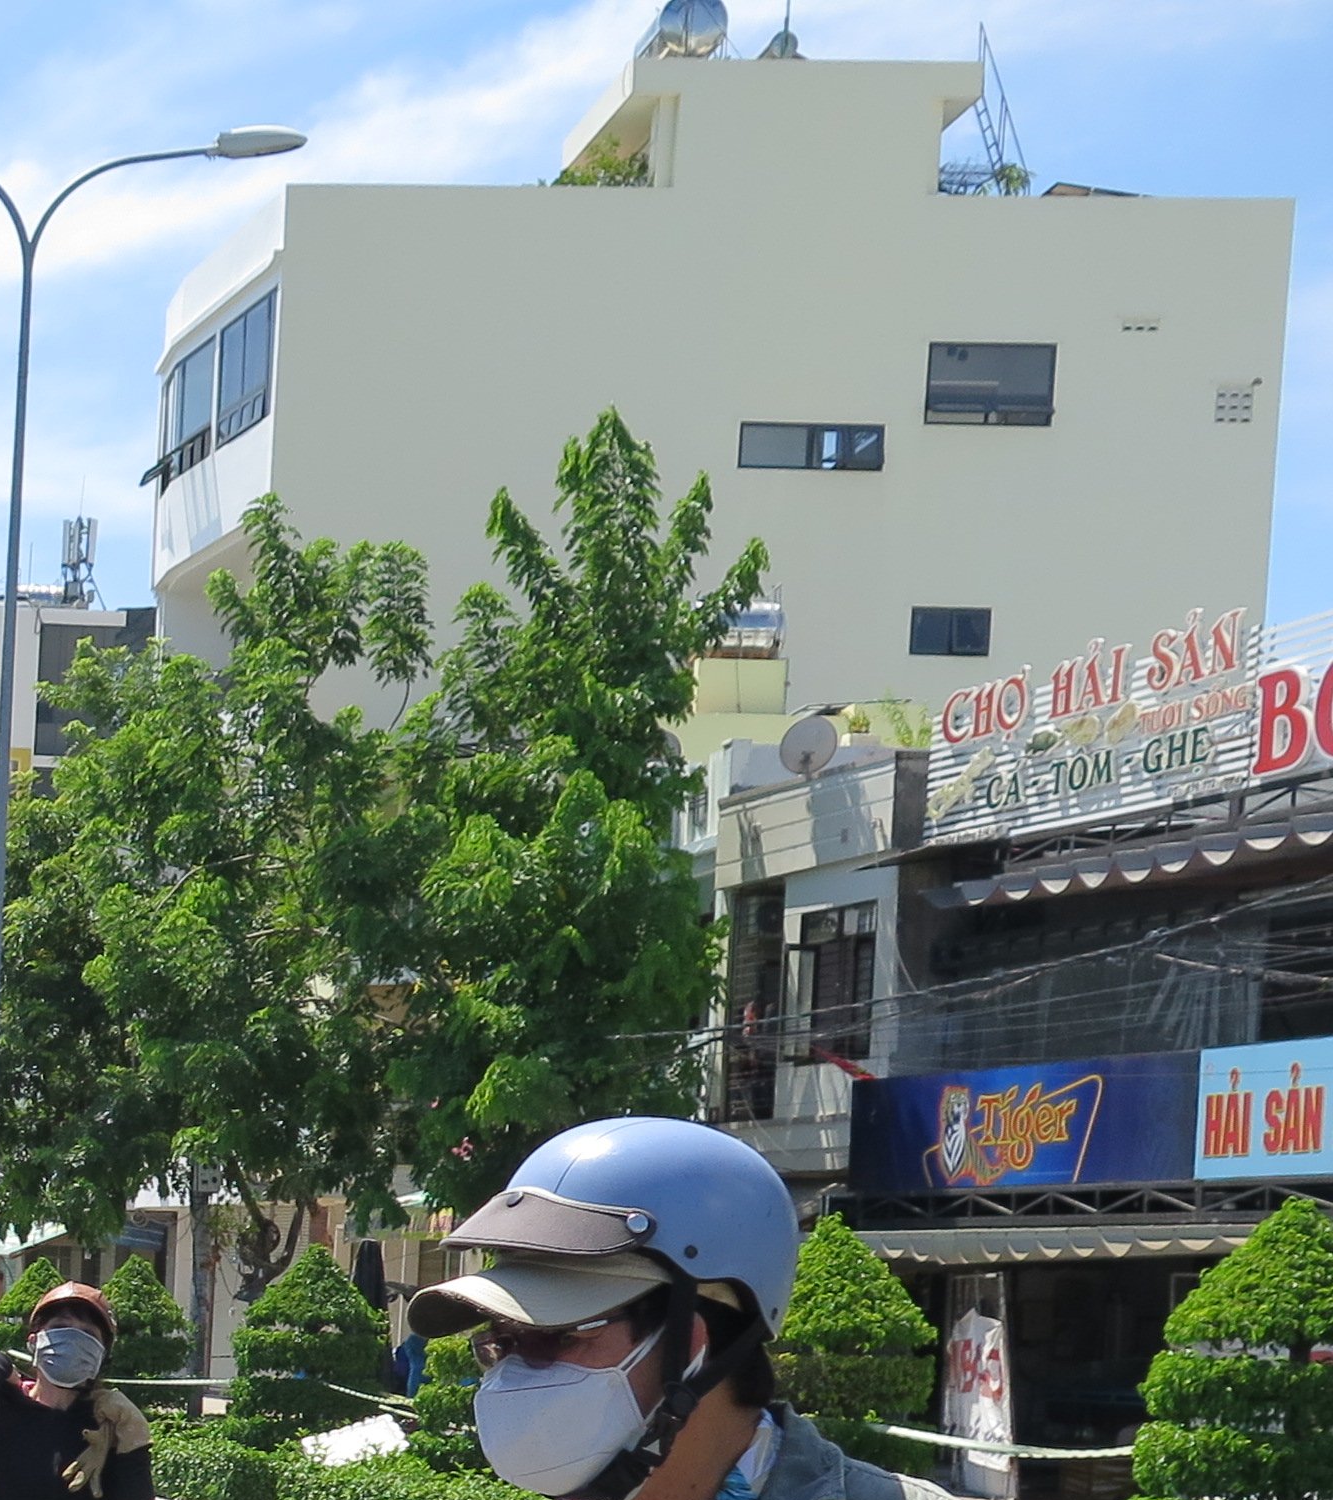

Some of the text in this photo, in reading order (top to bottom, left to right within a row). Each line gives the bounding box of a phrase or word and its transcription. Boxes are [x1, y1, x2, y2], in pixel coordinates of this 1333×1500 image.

[941, 608, 1247, 745] CHỢ HẢI SẢN
[986, 760, 1022, 809] CÁ
[1050, 749, 1113, 795] TÔM
[1143, 726, 1210, 775] GHẸ
[976, 1082, 1078, 1171] Tiger
[1203, 1062, 1325, 1158] HẢI SẢN
